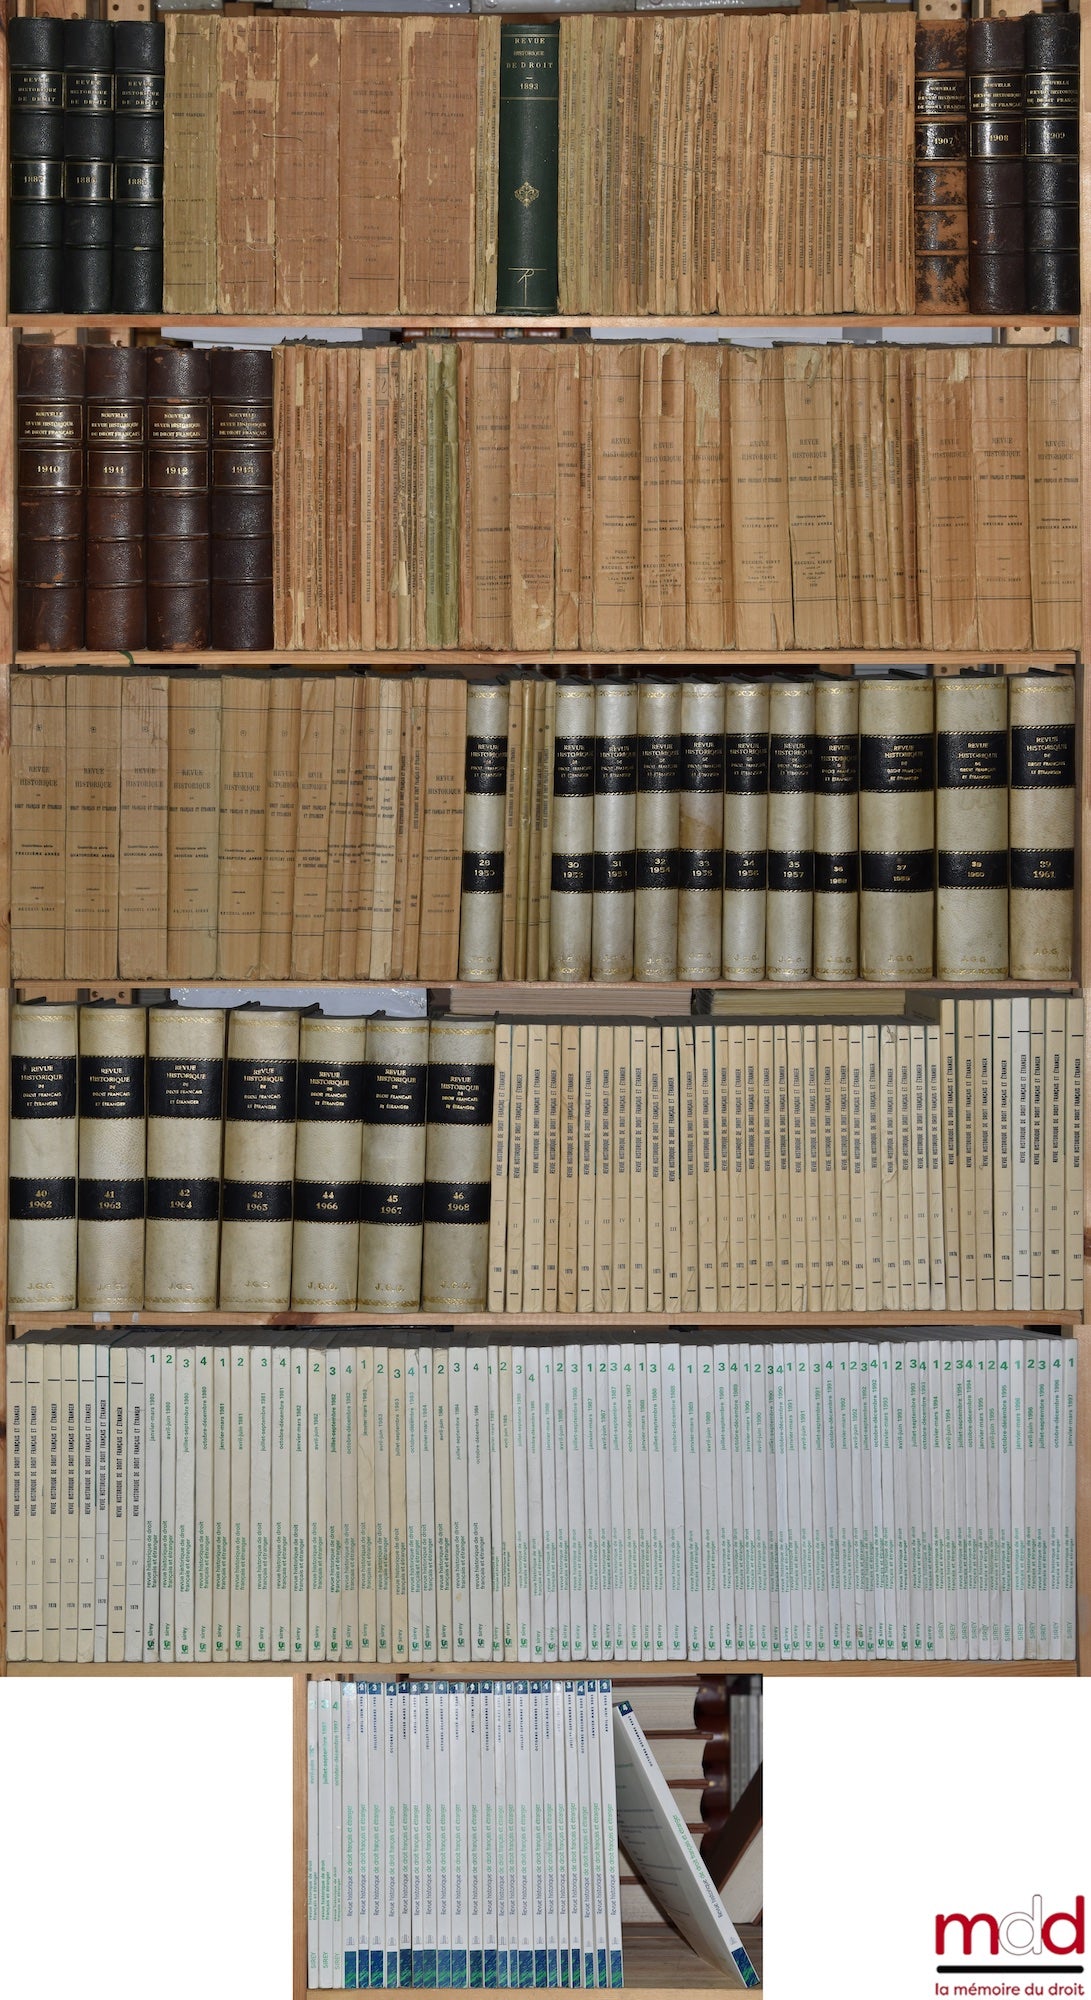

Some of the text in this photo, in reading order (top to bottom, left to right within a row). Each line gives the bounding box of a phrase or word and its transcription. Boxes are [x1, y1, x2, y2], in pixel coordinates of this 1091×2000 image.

[36, 1190, 48, 1198] 40
[104, 1190, 115, 1198] 41
[179, 1189, 190, 1197] 42
[454, 1192, 464, 1200] 46
[386, 1195, 398, 1203] 45
[28, 1200, 52, 1208] 1962
[99, 1202, 122, 1210] 1963
[316, 1202, 338, 1210] 1966
[448, 1204, 470, 1212] 1968
[380, 1206, 402, 1214] 1967
[150, 1354, 156, 1363] 1
[166, 1354, 172, 1364] 2
[200, 1356, 207, 1366] 4
[184, 1359, 190, 1368] 3
[870, 1360, 878, 1368] 4
[978, 1361, 984, 1370] 1
[754, 1364, 762, 1372] 2
